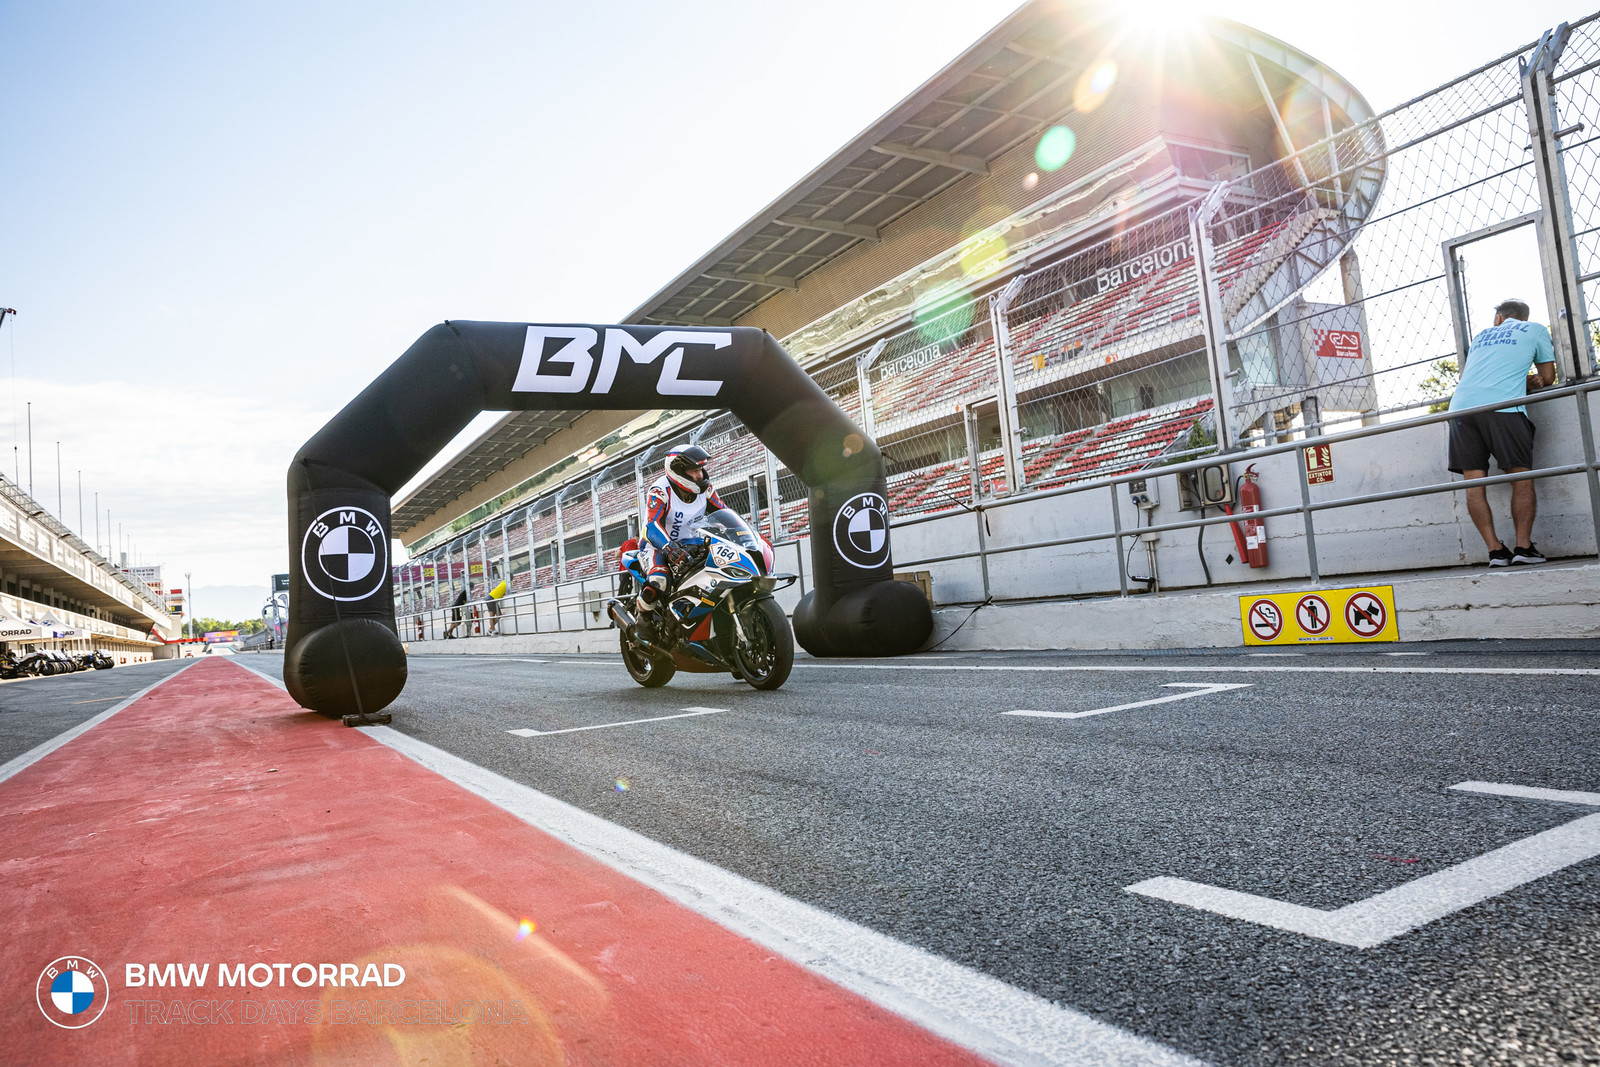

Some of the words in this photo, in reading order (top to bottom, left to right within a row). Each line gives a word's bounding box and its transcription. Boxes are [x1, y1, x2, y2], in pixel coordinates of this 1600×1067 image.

[1483, 339, 1517, 347] ALAMOS
[511, 325, 732, 396] BMC
[1308, 470, 1332, 479] EXTINTOR
[842, 496, 887, 520] BMW
[312, 511, 380, 538] BMW
[716, 546, 735, 560] 164
